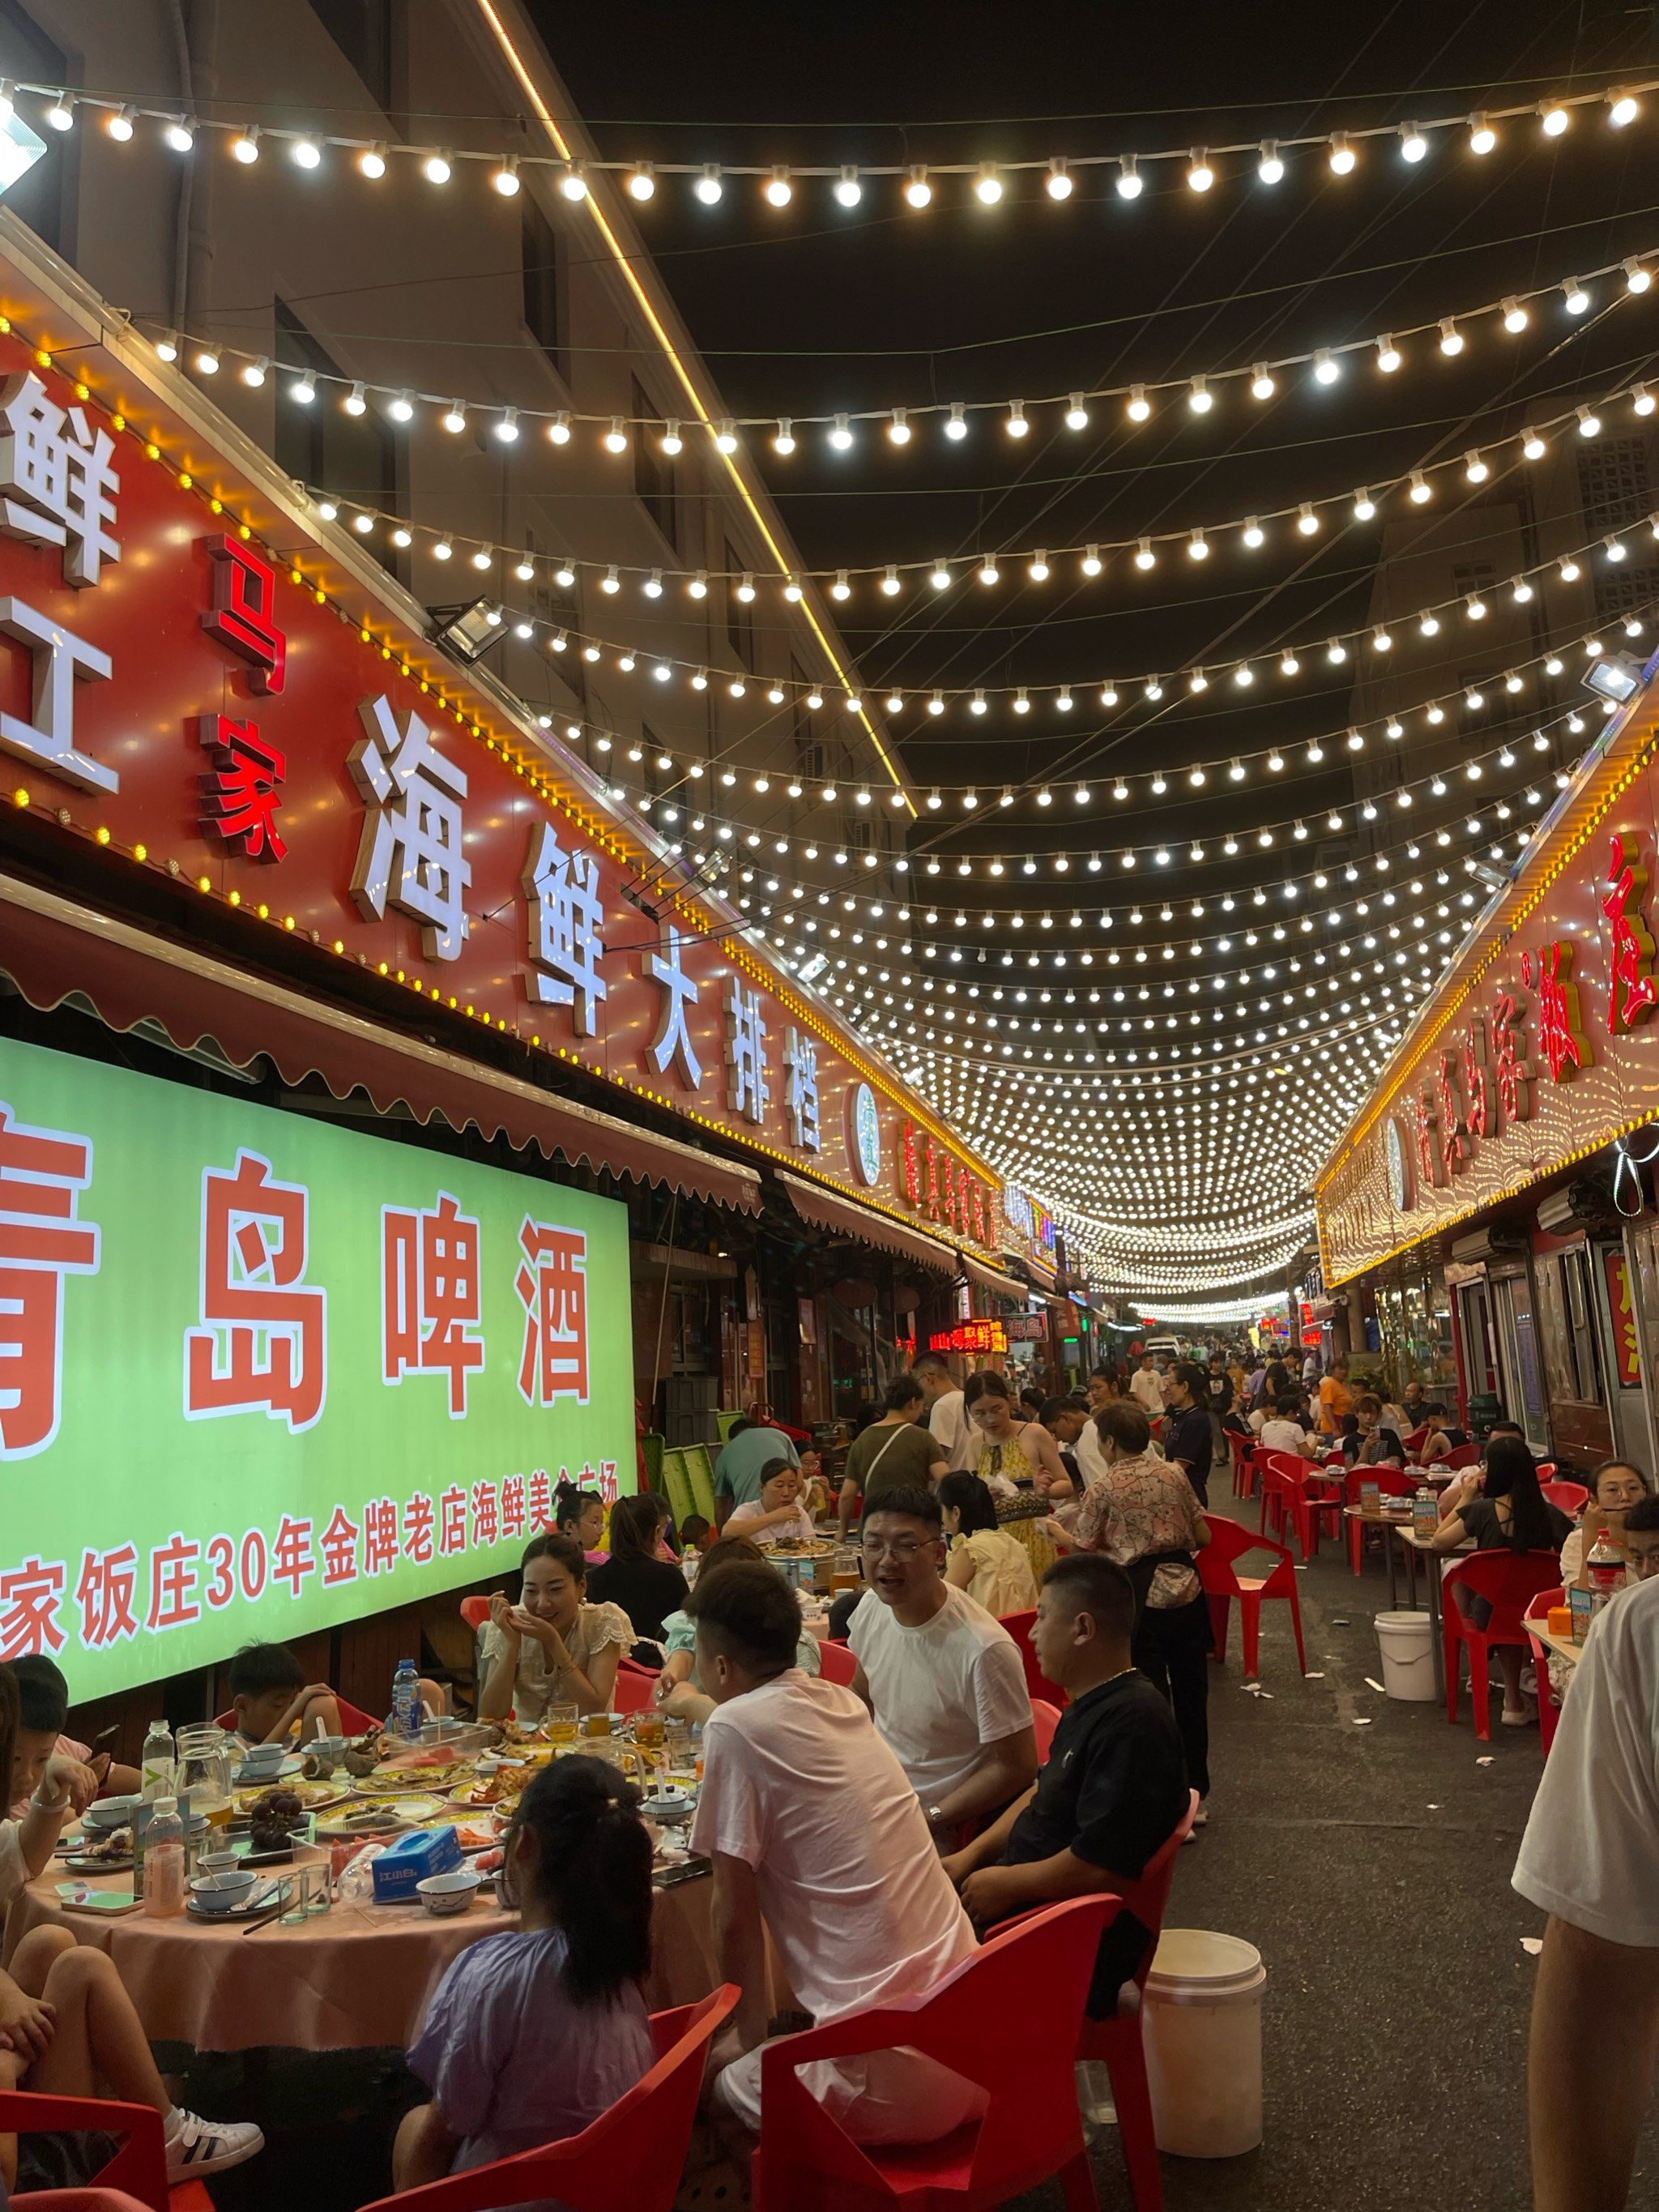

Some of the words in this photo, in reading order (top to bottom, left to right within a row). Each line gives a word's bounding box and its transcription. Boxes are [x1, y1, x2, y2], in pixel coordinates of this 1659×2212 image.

[0, 370, 120, 588] 鲜
[203, 533, 289, 864] 马家
[347, 694, 821, 1154] 海鲜大排档
